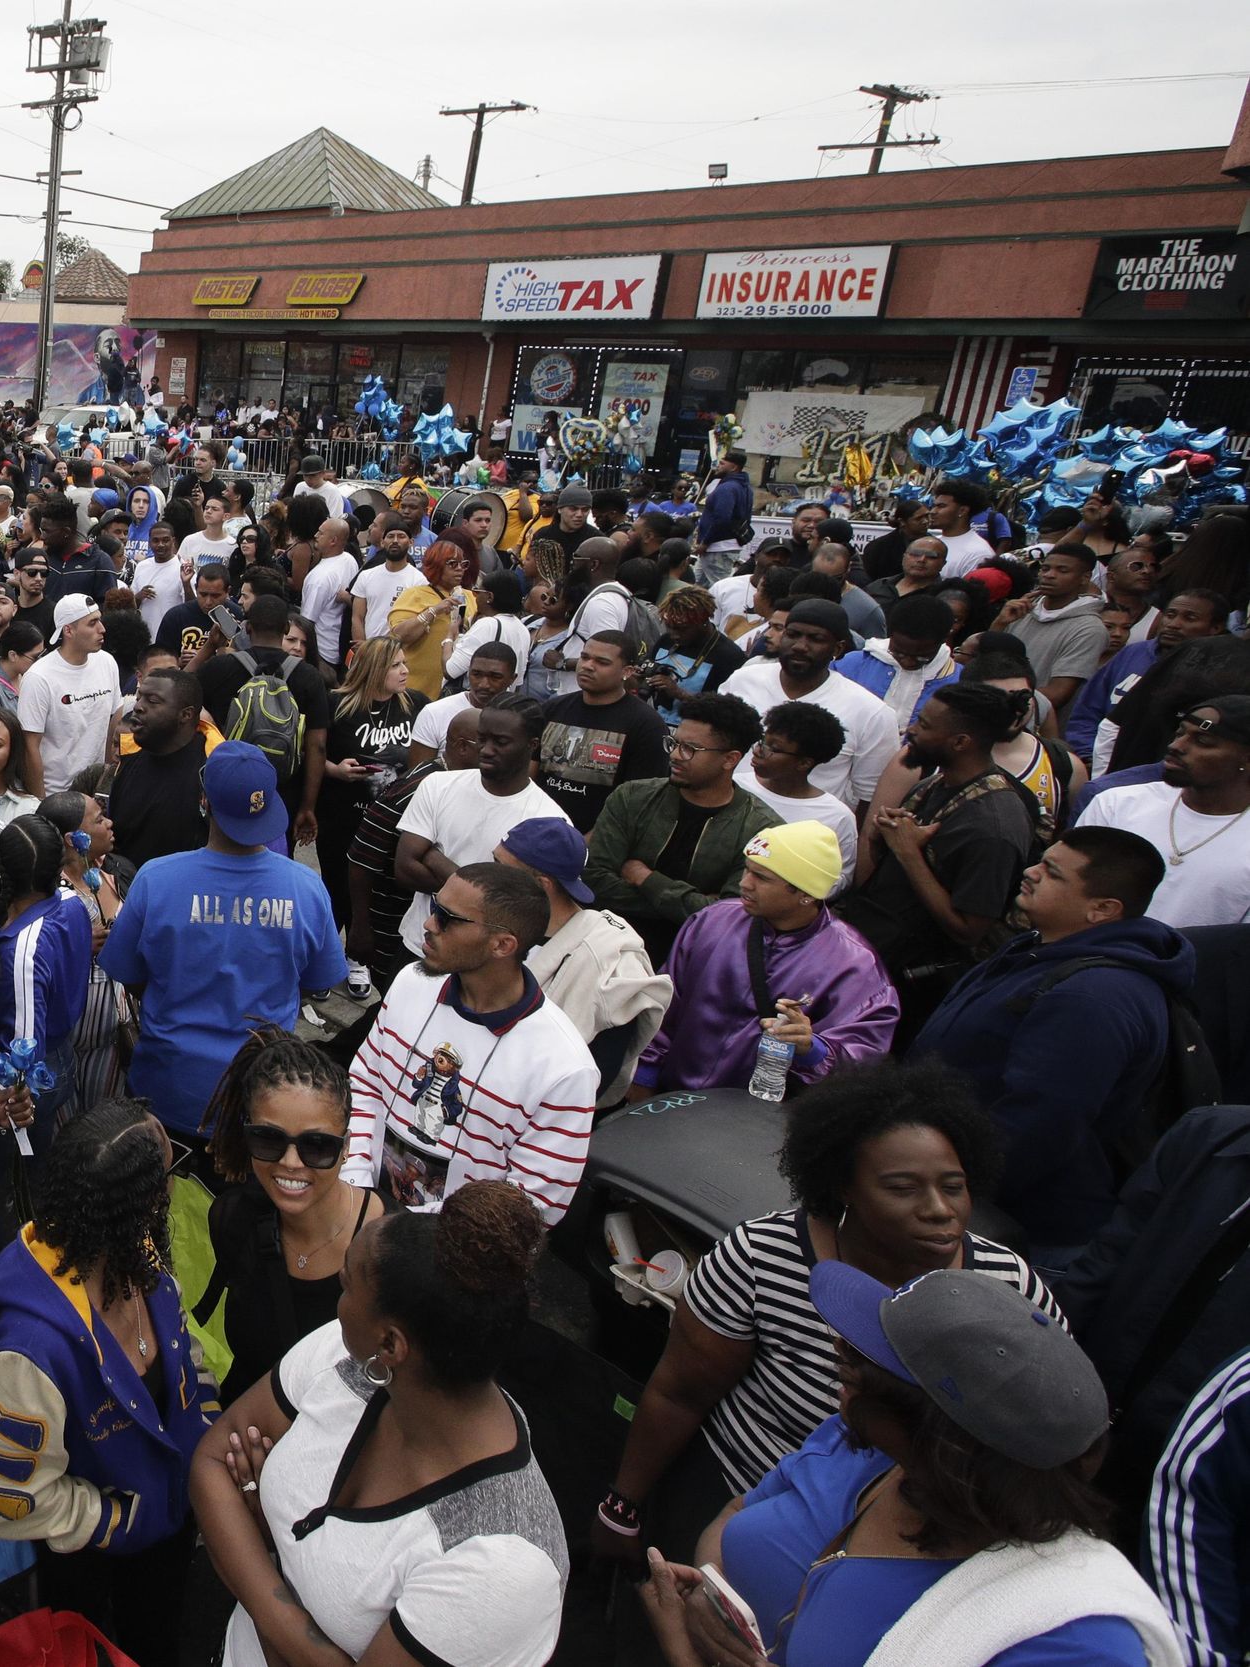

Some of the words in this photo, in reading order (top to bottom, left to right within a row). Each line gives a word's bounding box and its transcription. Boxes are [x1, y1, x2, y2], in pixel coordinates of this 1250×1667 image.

[1160, 238, 1203, 257] THE
[736, 251, 855, 267] Princess
[1116, 253, 1237, 275] MARATHON
[196, 280, 255, 299] MASTER
[291, 277, 359, 298] BURGER
[515, 281, 559, 297] HIGH
[706, 267, 878, 304] INSURANCE
[1117, 272, 1226, 292] CLOTHING
[557, 278, 645, 311] TAX
[504, 297, 560, 312] SPEED
[716, 304, 832, 316] 323-295-5000
[633, 371, 658, 382] TAX
[762, 527, 782, 535] LOS
[61, 689, 112, 705] Champion
[355, 720, 412, 755] Nipsey
[250, 790, 265, 814] S
[190, 894, 225, 924] ALL
[231, 896, 254, 926] AS
[258, 898, 294, 929] ONE
